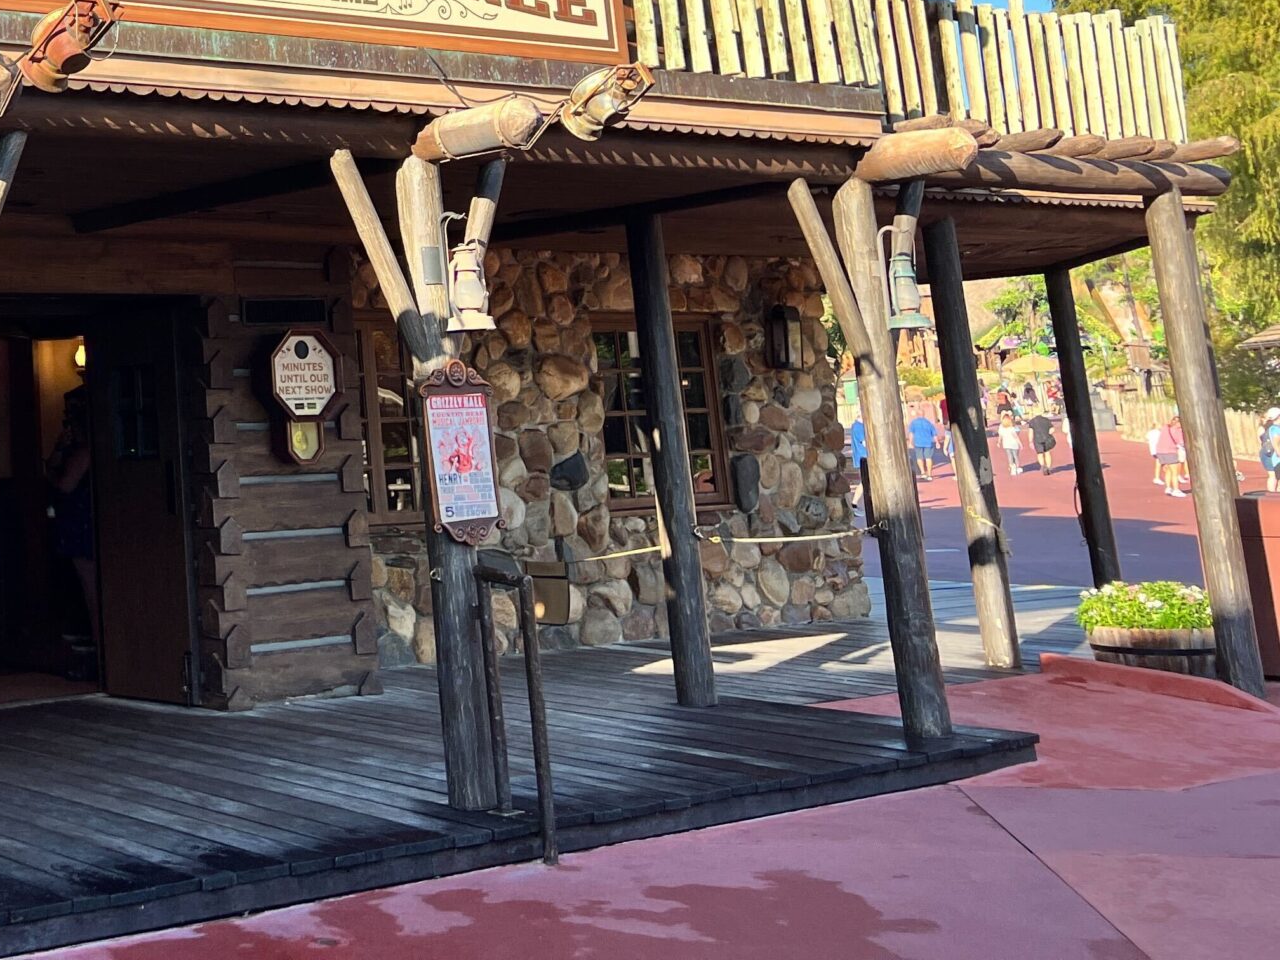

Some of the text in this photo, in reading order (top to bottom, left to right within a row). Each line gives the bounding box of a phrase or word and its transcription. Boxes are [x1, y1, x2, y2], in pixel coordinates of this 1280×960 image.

[282, 362, 324, 371] MINUTES
[280, 373, 329, 383] UNTIL OUR
[278, 385, 332, 395] NEXT SHOW
[431, 395, 483, 409] GRIZZLY HALL
[439, 473, 462, 485] HENRY
[445, 506, 454, 517] 5
